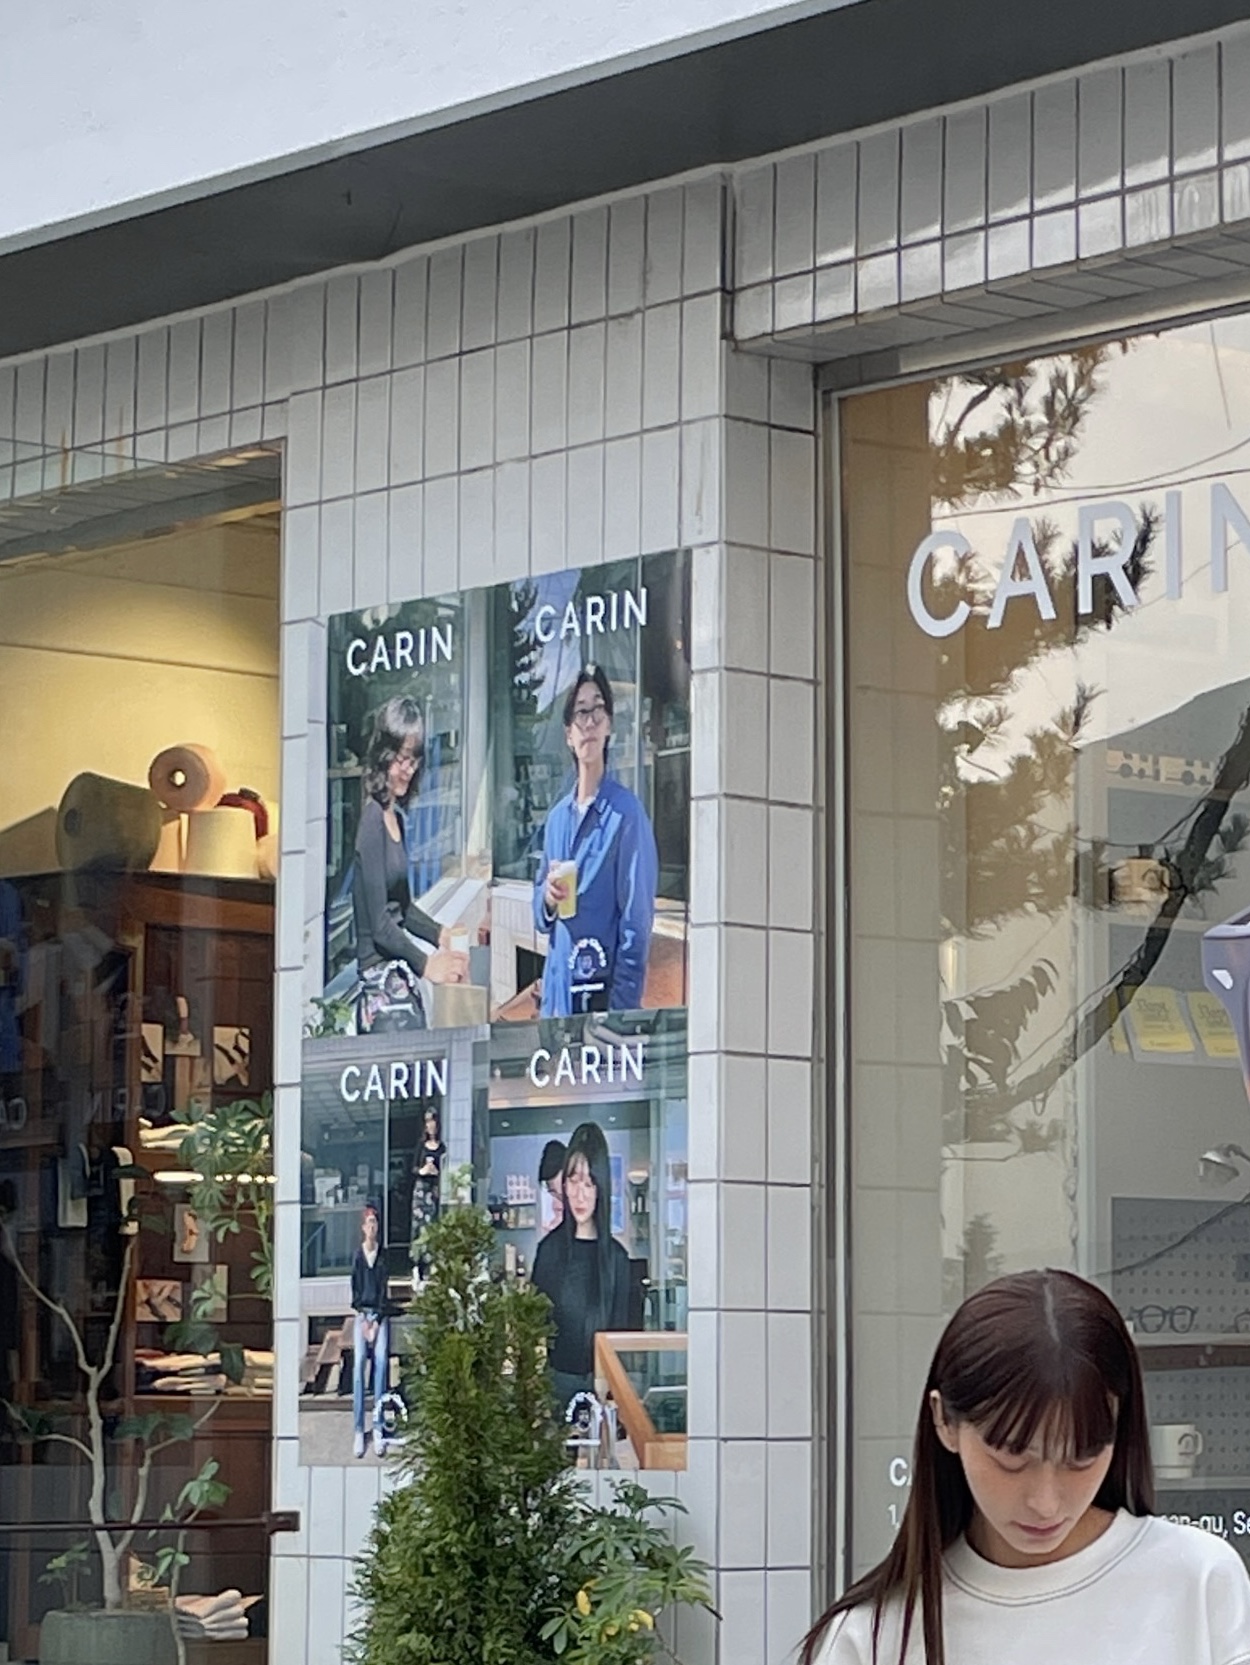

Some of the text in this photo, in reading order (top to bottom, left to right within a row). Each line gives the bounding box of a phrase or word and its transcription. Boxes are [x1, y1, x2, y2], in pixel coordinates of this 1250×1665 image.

[535, 587, 648, 642] CARIN
[346, 624, 453, 676] CARIN
[340, 1058, 448, 1101] CARIN
[530, 1043, 645, 1087] CARIN
